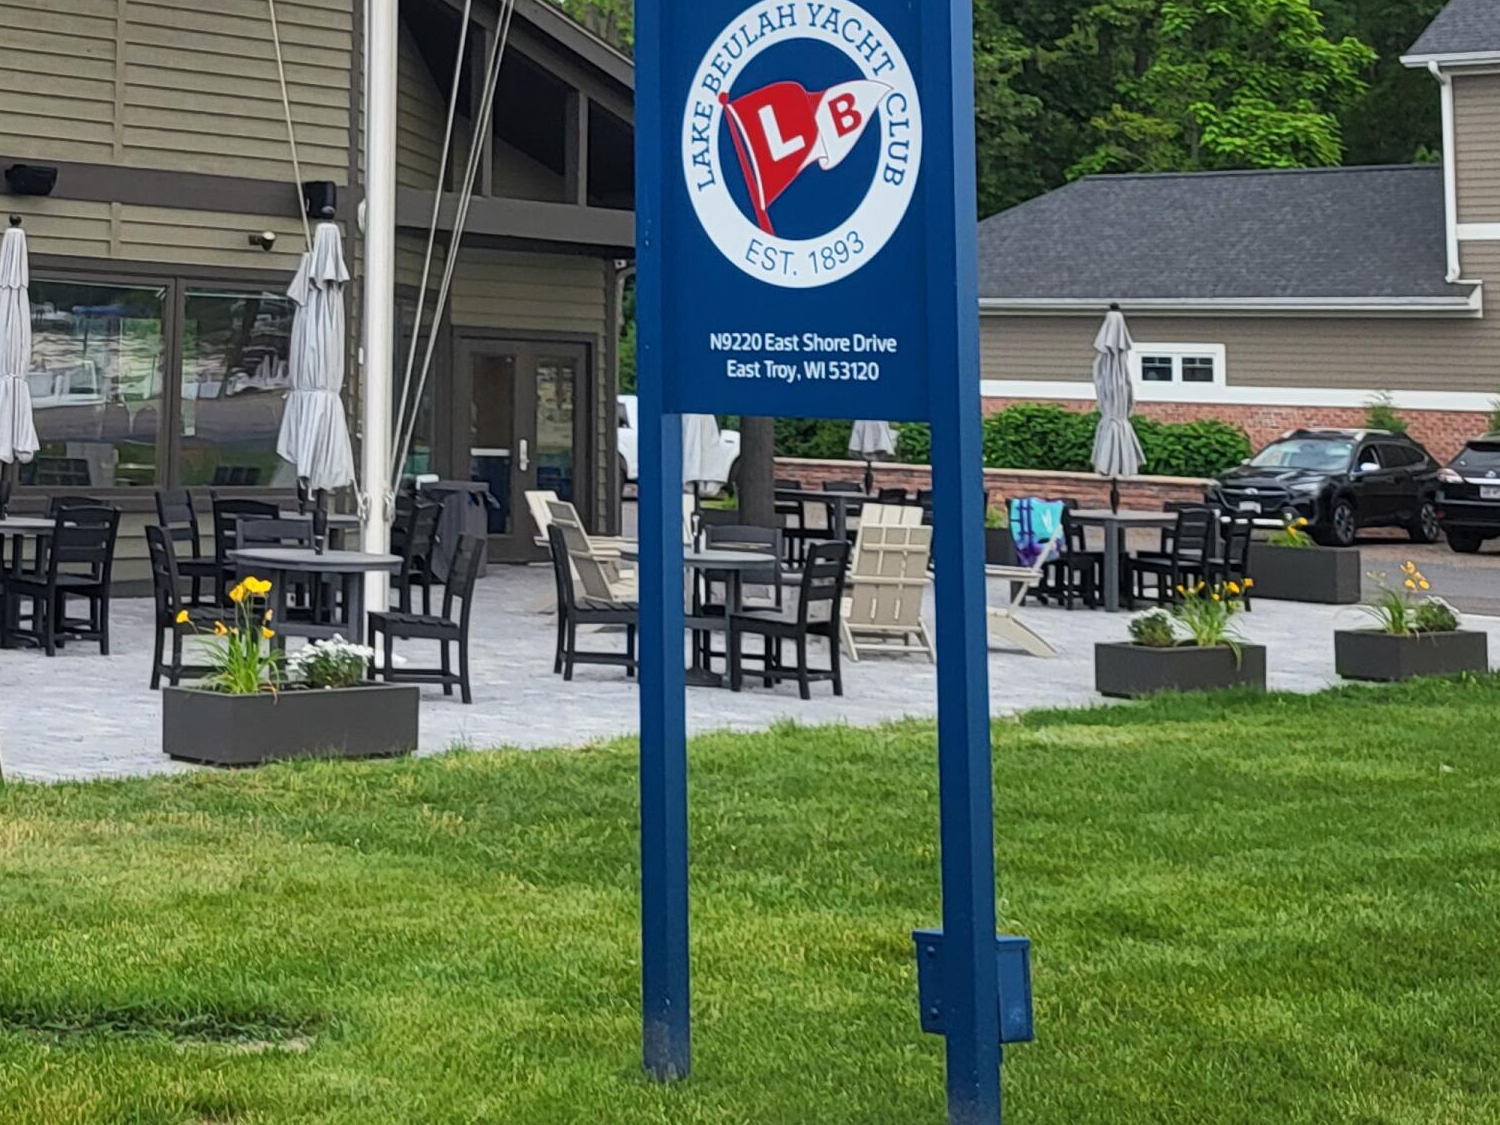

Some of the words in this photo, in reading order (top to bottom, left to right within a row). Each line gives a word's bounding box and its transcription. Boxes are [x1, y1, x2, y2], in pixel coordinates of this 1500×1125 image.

[701, 3, 797, 96] BEULAH
[806, 2, 896, 77] YACHT
[691, 101, 716, 192] LAKE
[757, 104, 806, 162] L
[827, 92, 862, 139] B
[882, 92, 910, 186] CLUB
[745, 238, 797, 276] EST.
[807, 230, 864, 274] 1893
[709, 332, 762, 351] N9220
[764, 332, 800, 352] East
[802, 332, 850, 352] Shore
[852, 333, 897, 353] Drive
[726, 359, 761, 378] East
[763, 359, 802, 383] Troy,
[803, 361, 826, 379] WI
[828, 361, 879, 381] 53120
